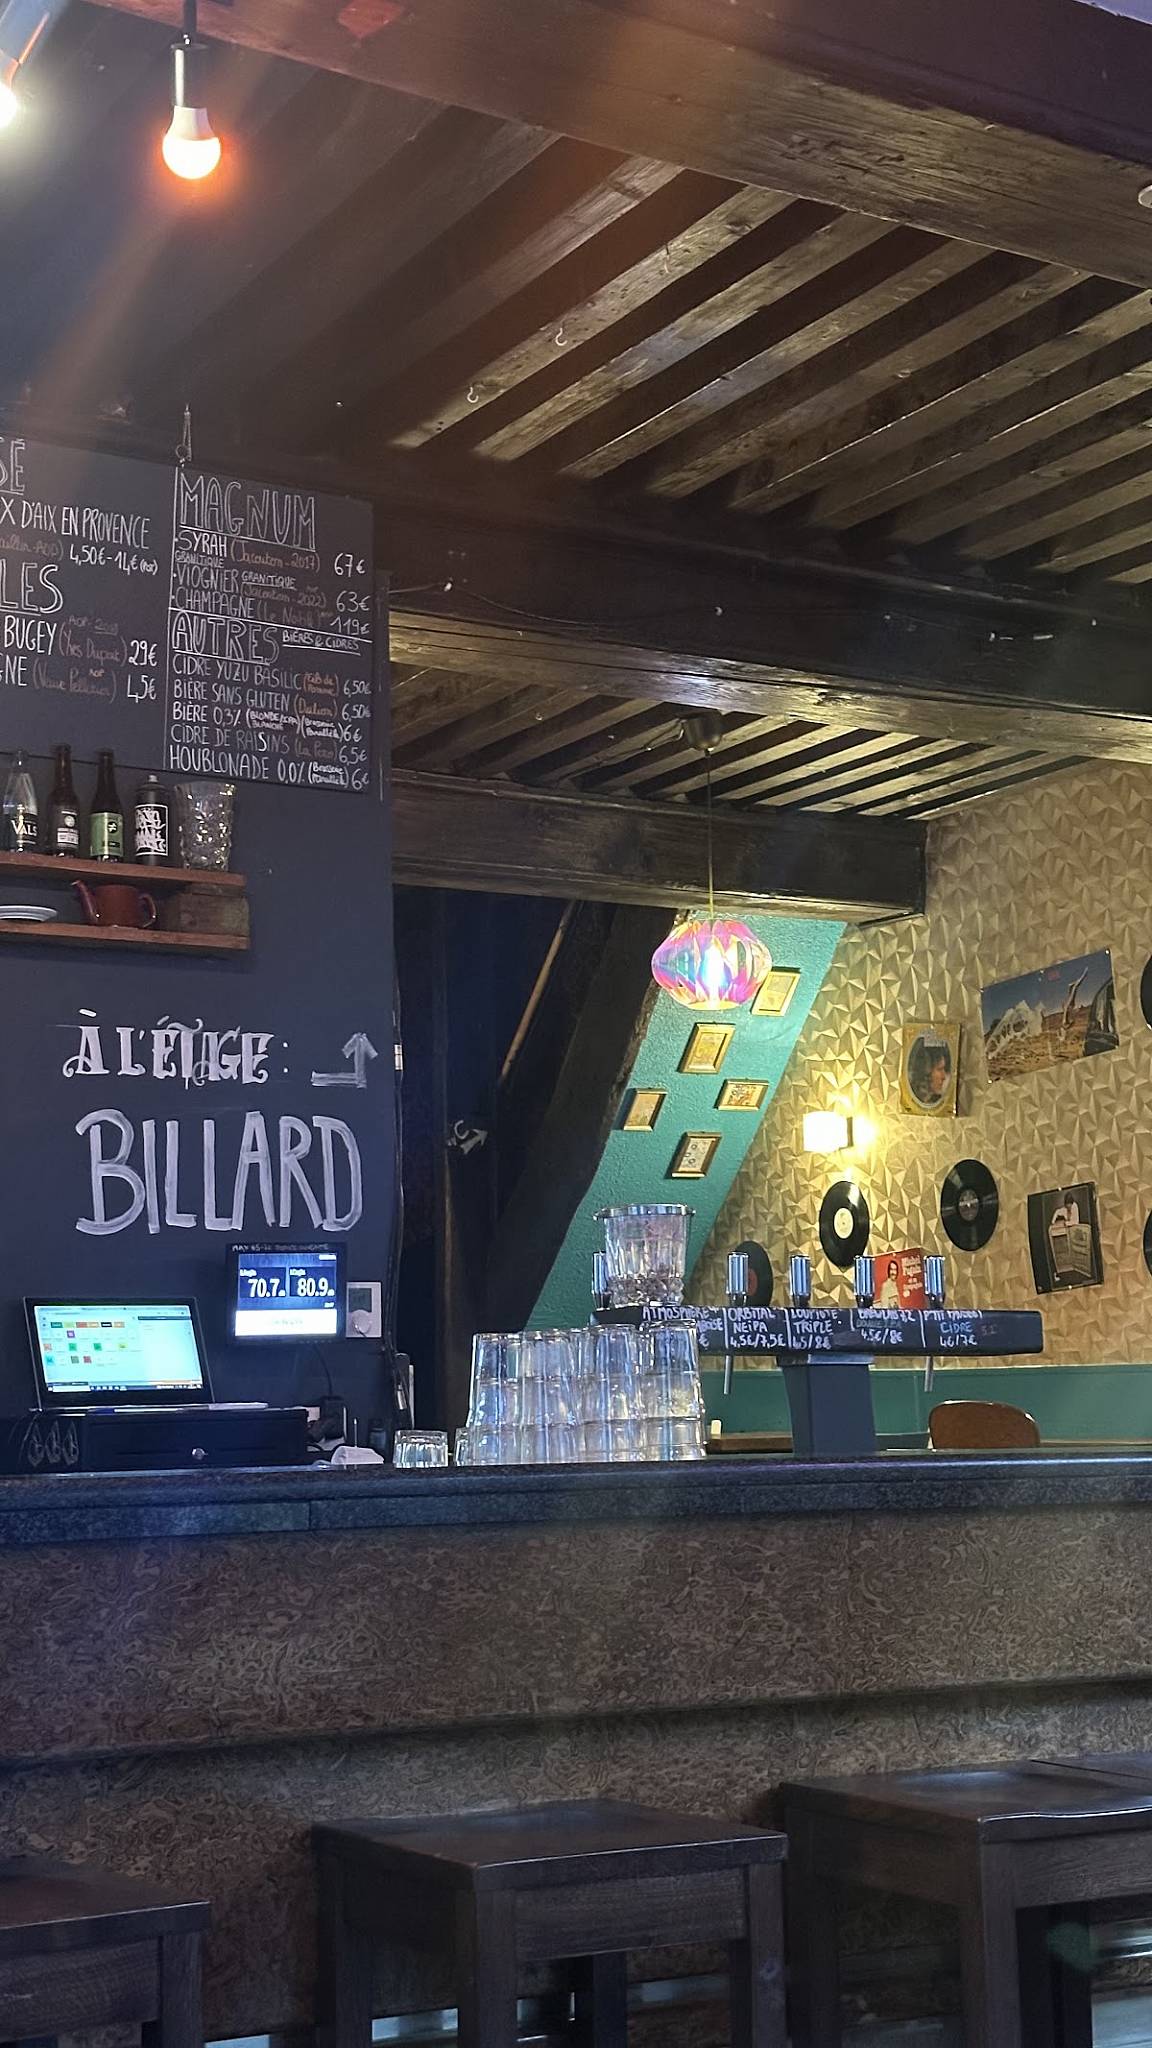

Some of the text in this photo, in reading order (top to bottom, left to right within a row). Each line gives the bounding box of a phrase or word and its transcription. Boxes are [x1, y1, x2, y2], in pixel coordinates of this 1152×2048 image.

[21, 500, 57, 533] D'AIX
[61, 506, 79, 536] EN
[82, 507, 151, 549] PROVENCE
[180, 472, 316, 549] MAGNUM
[177, 530, 227, 557] SYRAH
[335, 553, 366, 577] 67€
[175, 586, 256, 618] CHAMPAGNE
[330, 616, 370, 636] 119€
[177, 564, 239, 593] VIOGNIER
[241, 570, 297, 590] GRANITIQUE
[336, 590, 370, 612] 63€
[4, 615, 57, 655] BUGEY
[128, 639, 157, 666] 29€
[172, 611, 280, 664] AUTRES
[325, 638, 359, 650] CIDRES
[172, 653, 211, 676] CIDRE
[216, 660, 249, 682] YUZU
[254, 665, 301, 690] BASILIC
[343, 680, 372, 698] 6,50€
[173, 678, 208, 700] BIÈRE
[212, 682, 242, 705] SANS
[246, 688, 290, 711] GLUTEN
[171, 723, 210, 745] CIDRE
[214, 728, 231, 747] DE
[236, 730, 290, 754] RAISINS
[339, 746, 368, 766] 6,5€
[172, 701, 208, 722] BIÈRE
[343, 724, 362, 742] 6€
[169, 744, 270, 779] HOUBLONADE
[351, 768, 369, 790] 6€
[62, 1008, 110, 1078] À
[75, 1108, 363, 1235] BILLARD
[247, 1278, 280, 1298] 70.7
[297, 1277, 328, 1297] 80.9
[727, 1306, 776, 1322] ORBITAL
[793, 1320, 833, 1334] TRIPLE
[940, 1321, 973, 1334] CIDRE
